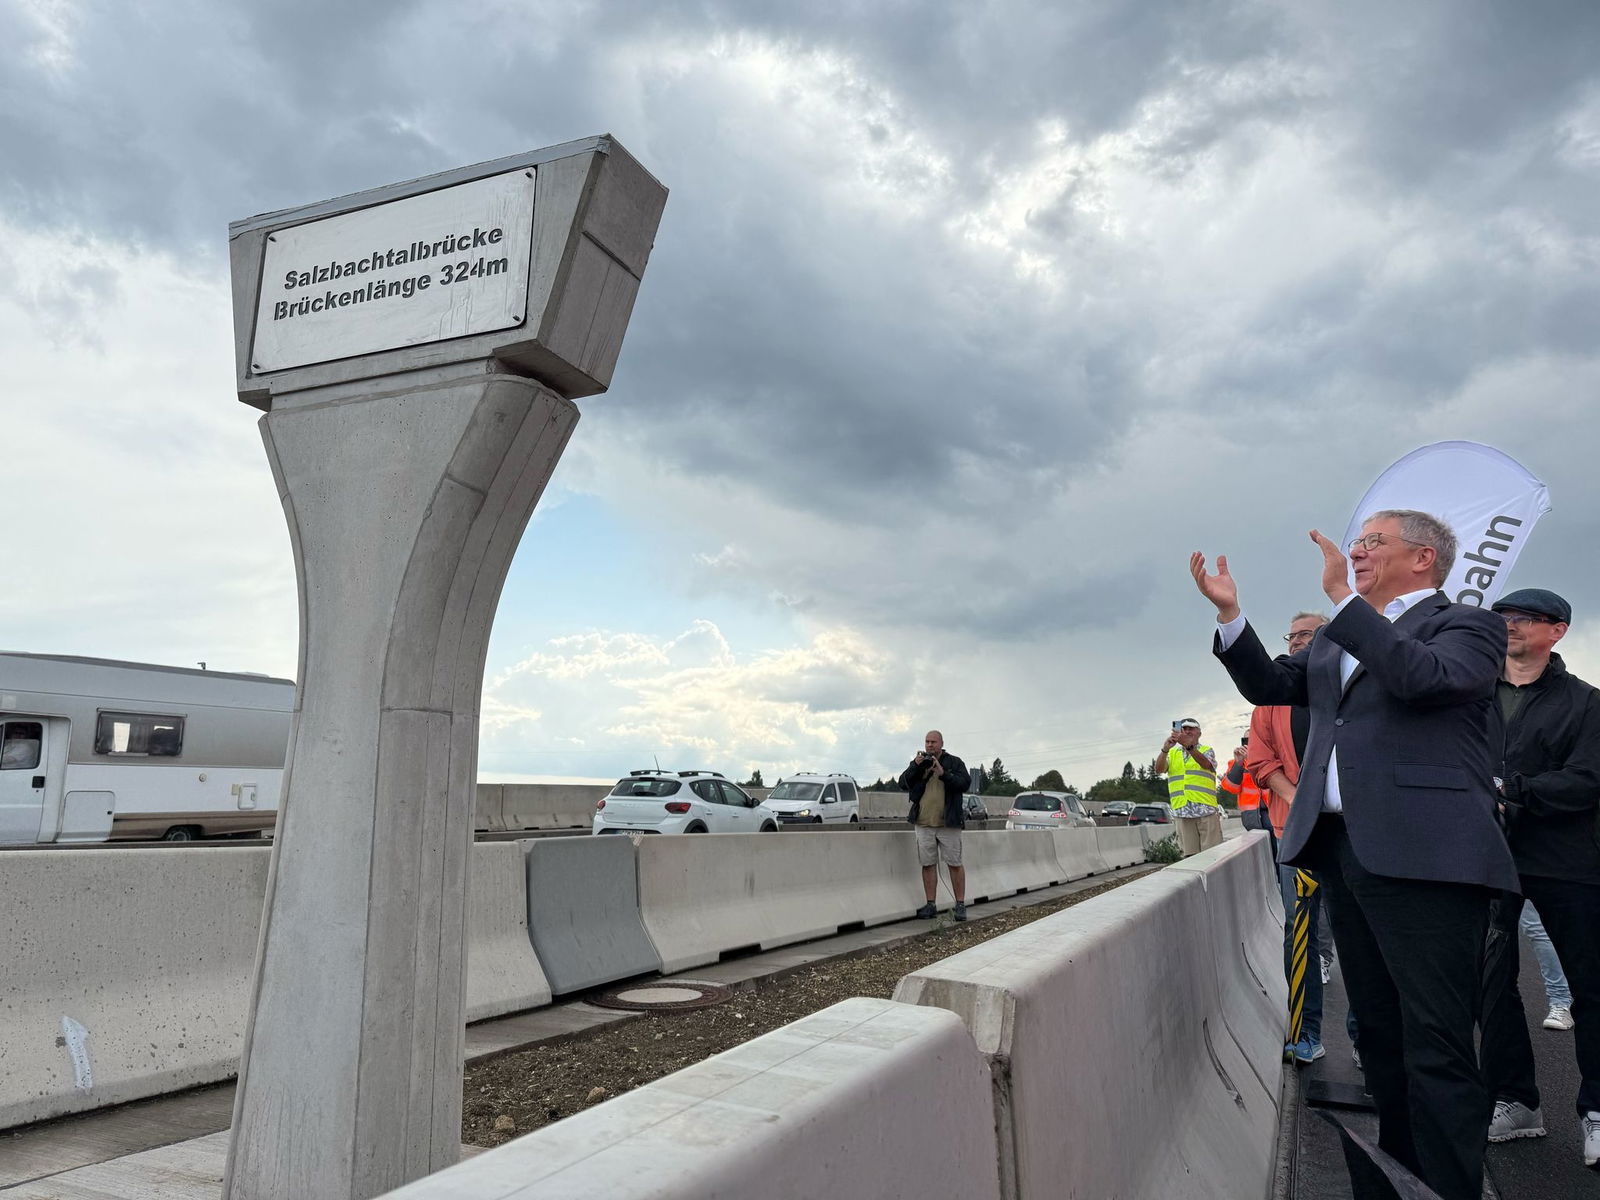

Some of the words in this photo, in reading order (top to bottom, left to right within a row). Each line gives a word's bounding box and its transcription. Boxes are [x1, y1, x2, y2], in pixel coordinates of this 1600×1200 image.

[273, 274, 432, 321] Brückenlänge
[439, 256, 509, 286] 324m
[284, 226, 503, 291] Salzbachtalbrücke
